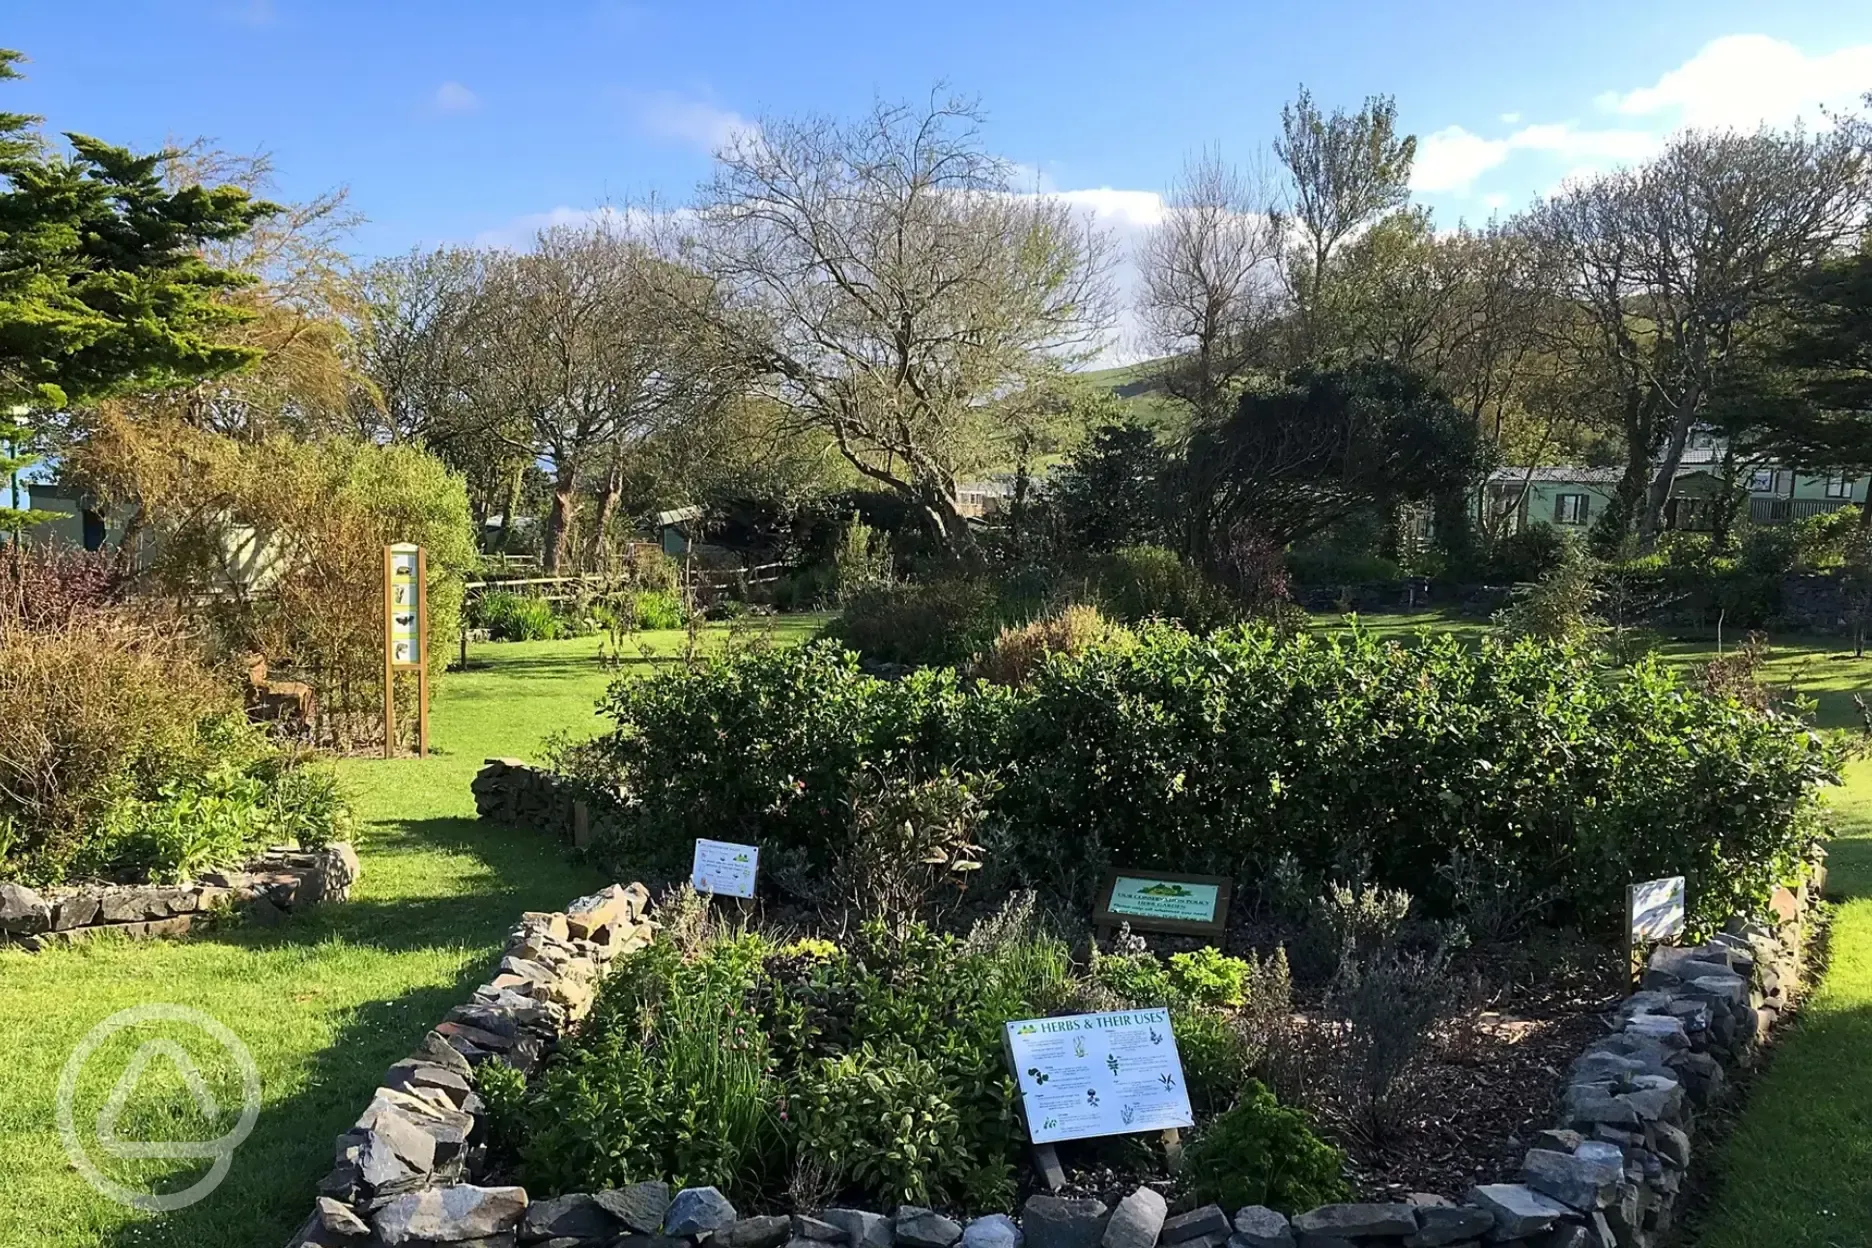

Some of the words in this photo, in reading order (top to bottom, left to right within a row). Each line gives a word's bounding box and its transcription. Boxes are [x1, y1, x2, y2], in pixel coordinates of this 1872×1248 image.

[1040, 1019, 1080, 1033] HERBS
[1083, 1019, 1093, 1030] &
[1096, 1014, 1131, 1028] THEIR
[1134, 1012, 1163, 1025] USES
